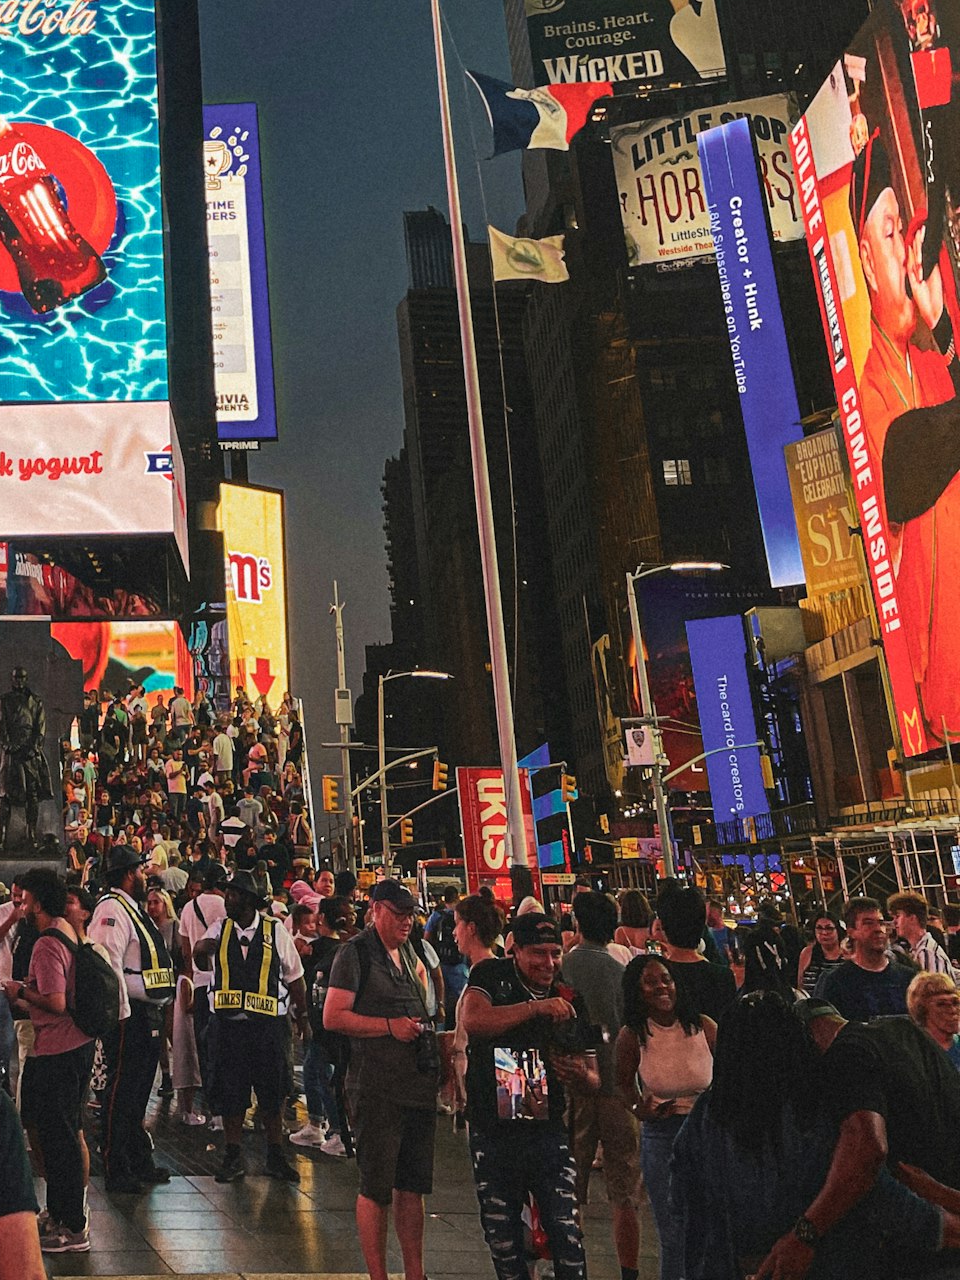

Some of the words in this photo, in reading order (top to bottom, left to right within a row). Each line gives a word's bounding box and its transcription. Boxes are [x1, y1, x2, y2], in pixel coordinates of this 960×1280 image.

[544, 20, 600, 38] Brains.
[604, 11, 654, 28] Heart.
[565, 31, 637, 50] Courage.
[631, 111, 714, 171] LITTLE
[708, 203, 722, 232] 1.8M
[658, 244, 693, 256] Westside
[729, 196, 749, 264] Creator
[744, 282, 763, 331] Hunk
[713, 234, 733, 311] Subscribers
[818, 252, 844, 355] HERSHEY'S
[726, 312, 737, 334] on
[730, 336, 747, 394] YouTube
[19, 450, 104, 481] yogurt
[841, 387, 872, 491] COME
[861, 495, 900, 634] INSIDE!
[717, 675, 728, 700] The
[721, 702, 733, 732] card
[728, 755, 745, 811] creators
[147, 971, 170, 986] TIMES
[217, 990, 241, 1007] TIMES
[245, 995, 274, 1013] SQUARE
